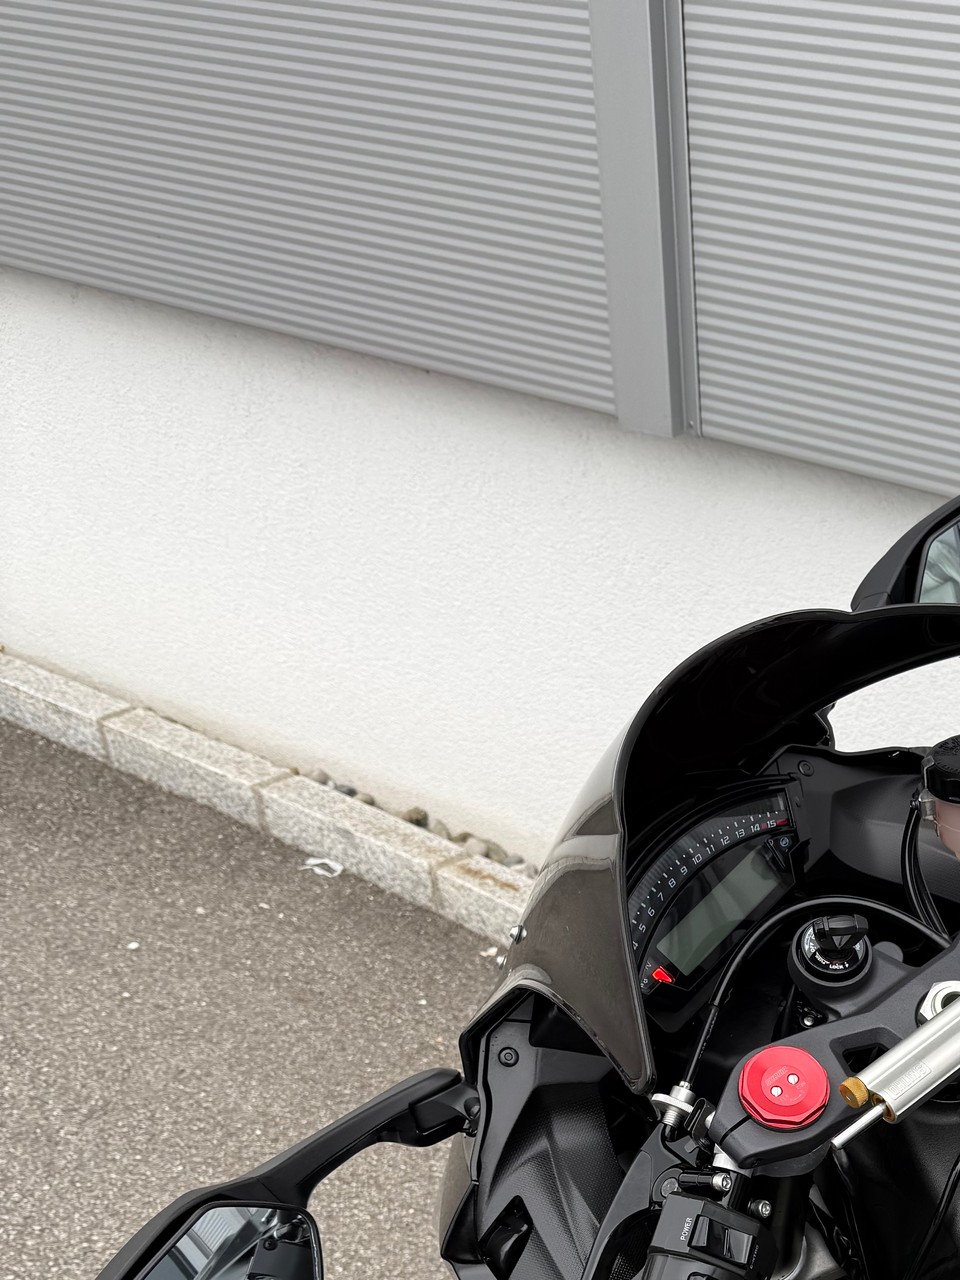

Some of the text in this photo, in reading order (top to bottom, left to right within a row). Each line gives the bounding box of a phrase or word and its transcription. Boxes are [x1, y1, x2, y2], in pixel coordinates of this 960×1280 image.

[638, 923, 647, 933] 5
[647, 906, 656, 917] 6
[657, 892, 665, 902] 7
[668, 878, 677, 888] 8
[680, 865, 689, 876] 9
[692, 853, 703, 865] 10
[705, 844, 716, 855] 11
[720, 835, 731, 846] 12
[735, 828, 746, 839] 13
[750, 823, 761, 832] 14
[766, 819, 777, 829] 15
[680, 1217, 693, 1241] POWER
